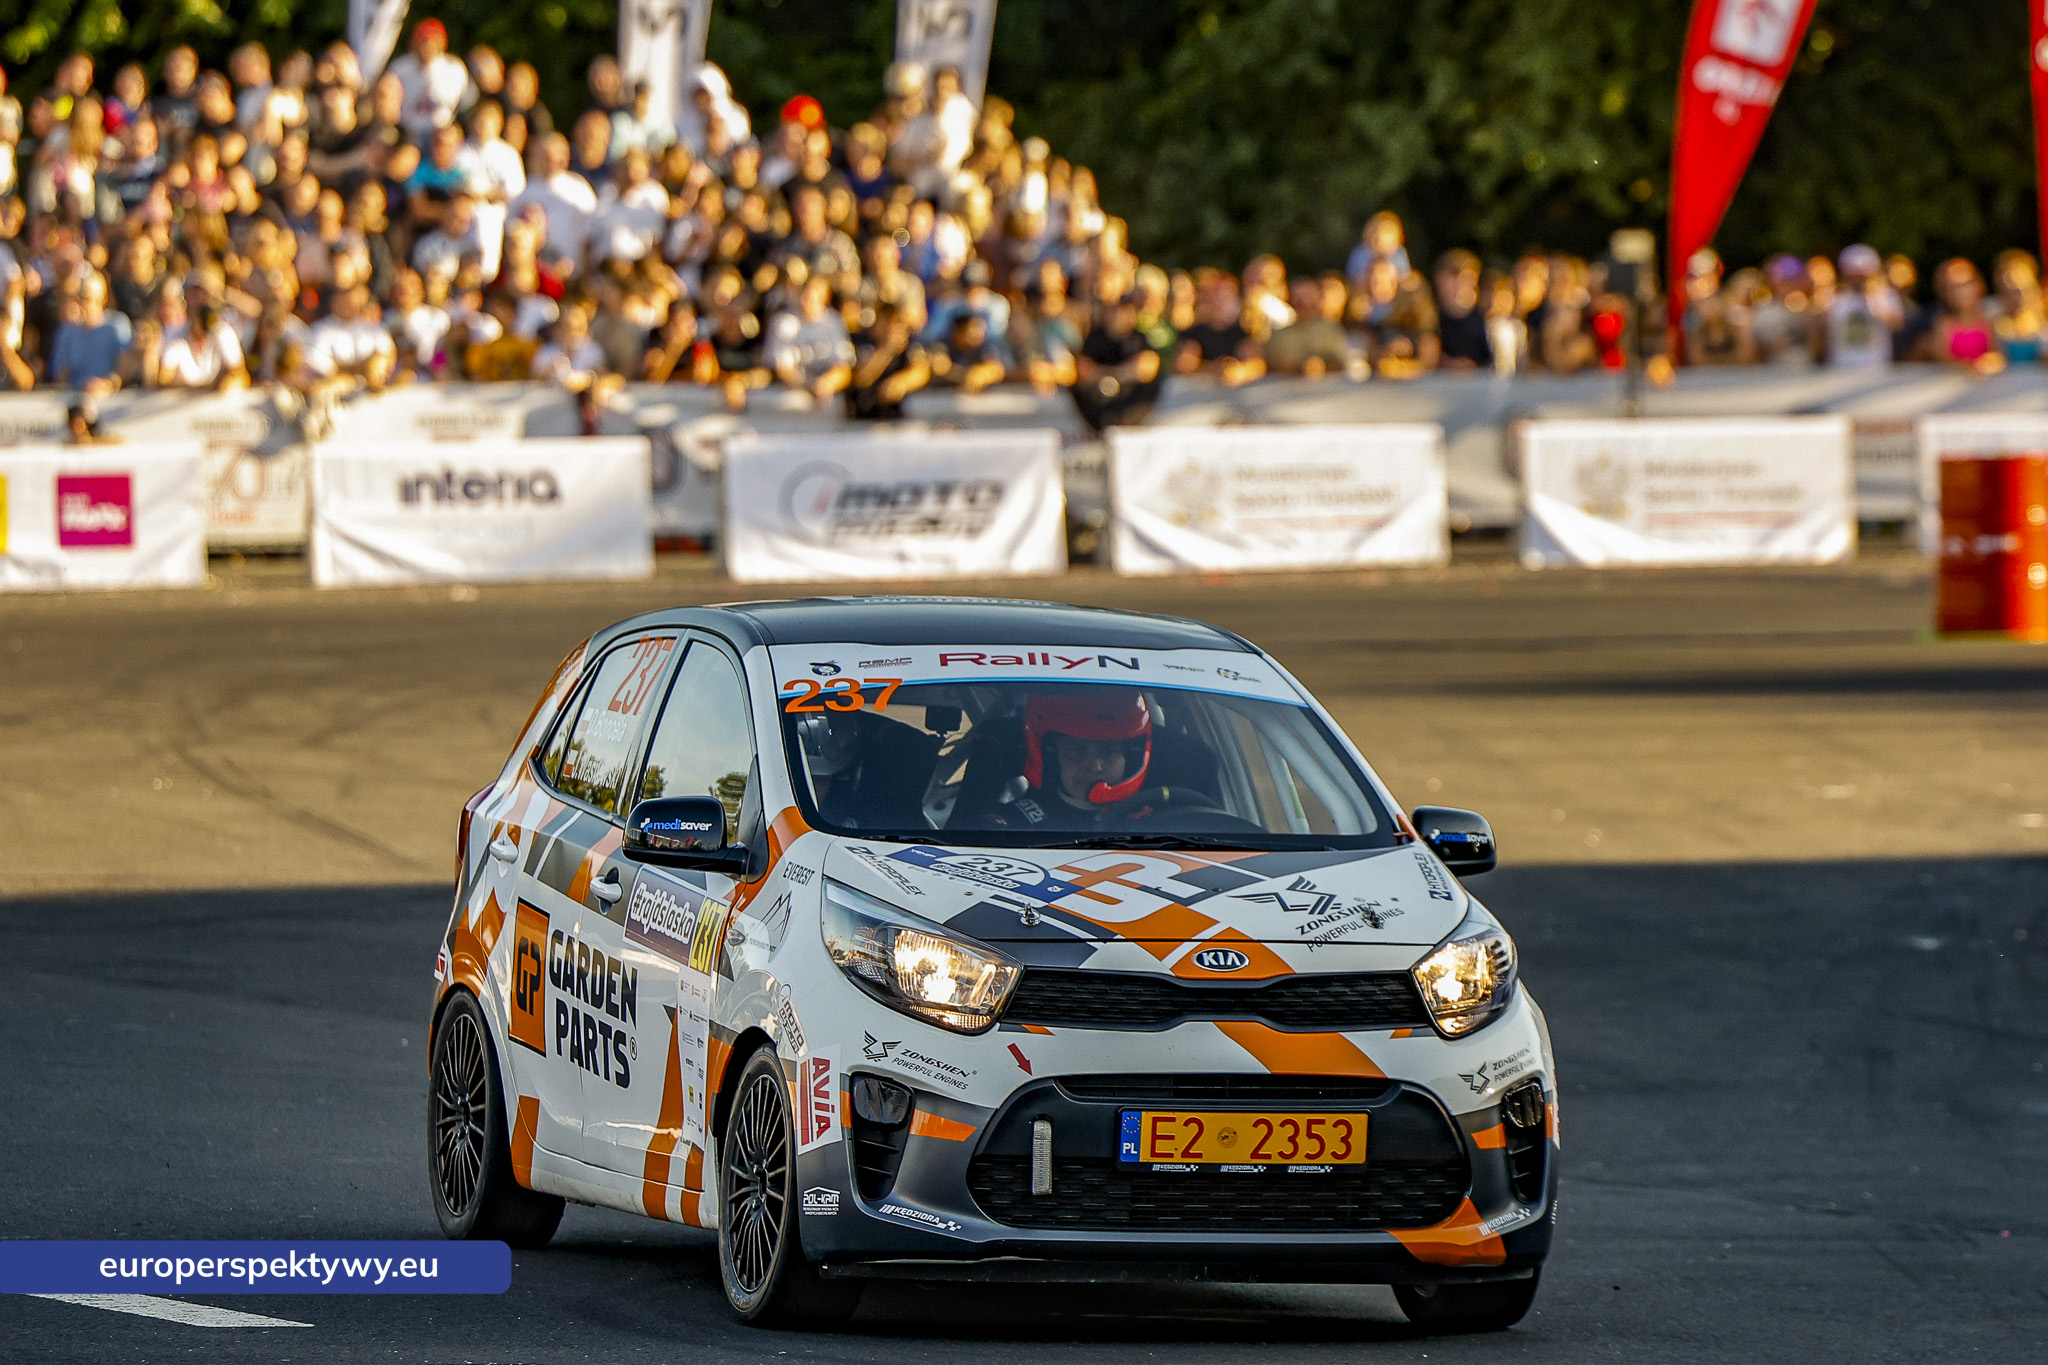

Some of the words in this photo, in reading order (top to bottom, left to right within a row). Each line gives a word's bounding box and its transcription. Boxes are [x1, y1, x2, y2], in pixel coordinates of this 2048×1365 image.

[608, 634, 676, 716] 237
[783, 678, 903, 713] 237
[653, 818, 712, 831] medisaver
[1441, 830, 1489, 844] medisaver
[783, 861, 815, 887] EVEREST
[958, 857, 1039, 877] 237
[1296, 900, 1382, 936] ZONGSHEN
[690, 898, 727, 974] 237
[1306, 920, 1365, 953] POWERFUL
[1202, 952, 1241, 966] KIA
[549, 928, 638, 1031] GARDEN
[891, 1057, 933, 1077] POWERFUL
[933, 1072, 969, 1090] ENGINES
[901, 1048, 971, 1078] ZONGSHEN
[1492, 1048, 1531, 1071] ZONGSHEN
[1123, 1142, 1138, 1154] PL
[1150, 1116, 1205, 1159] E2
[1250, 1117, 1354, 1160] 2353
